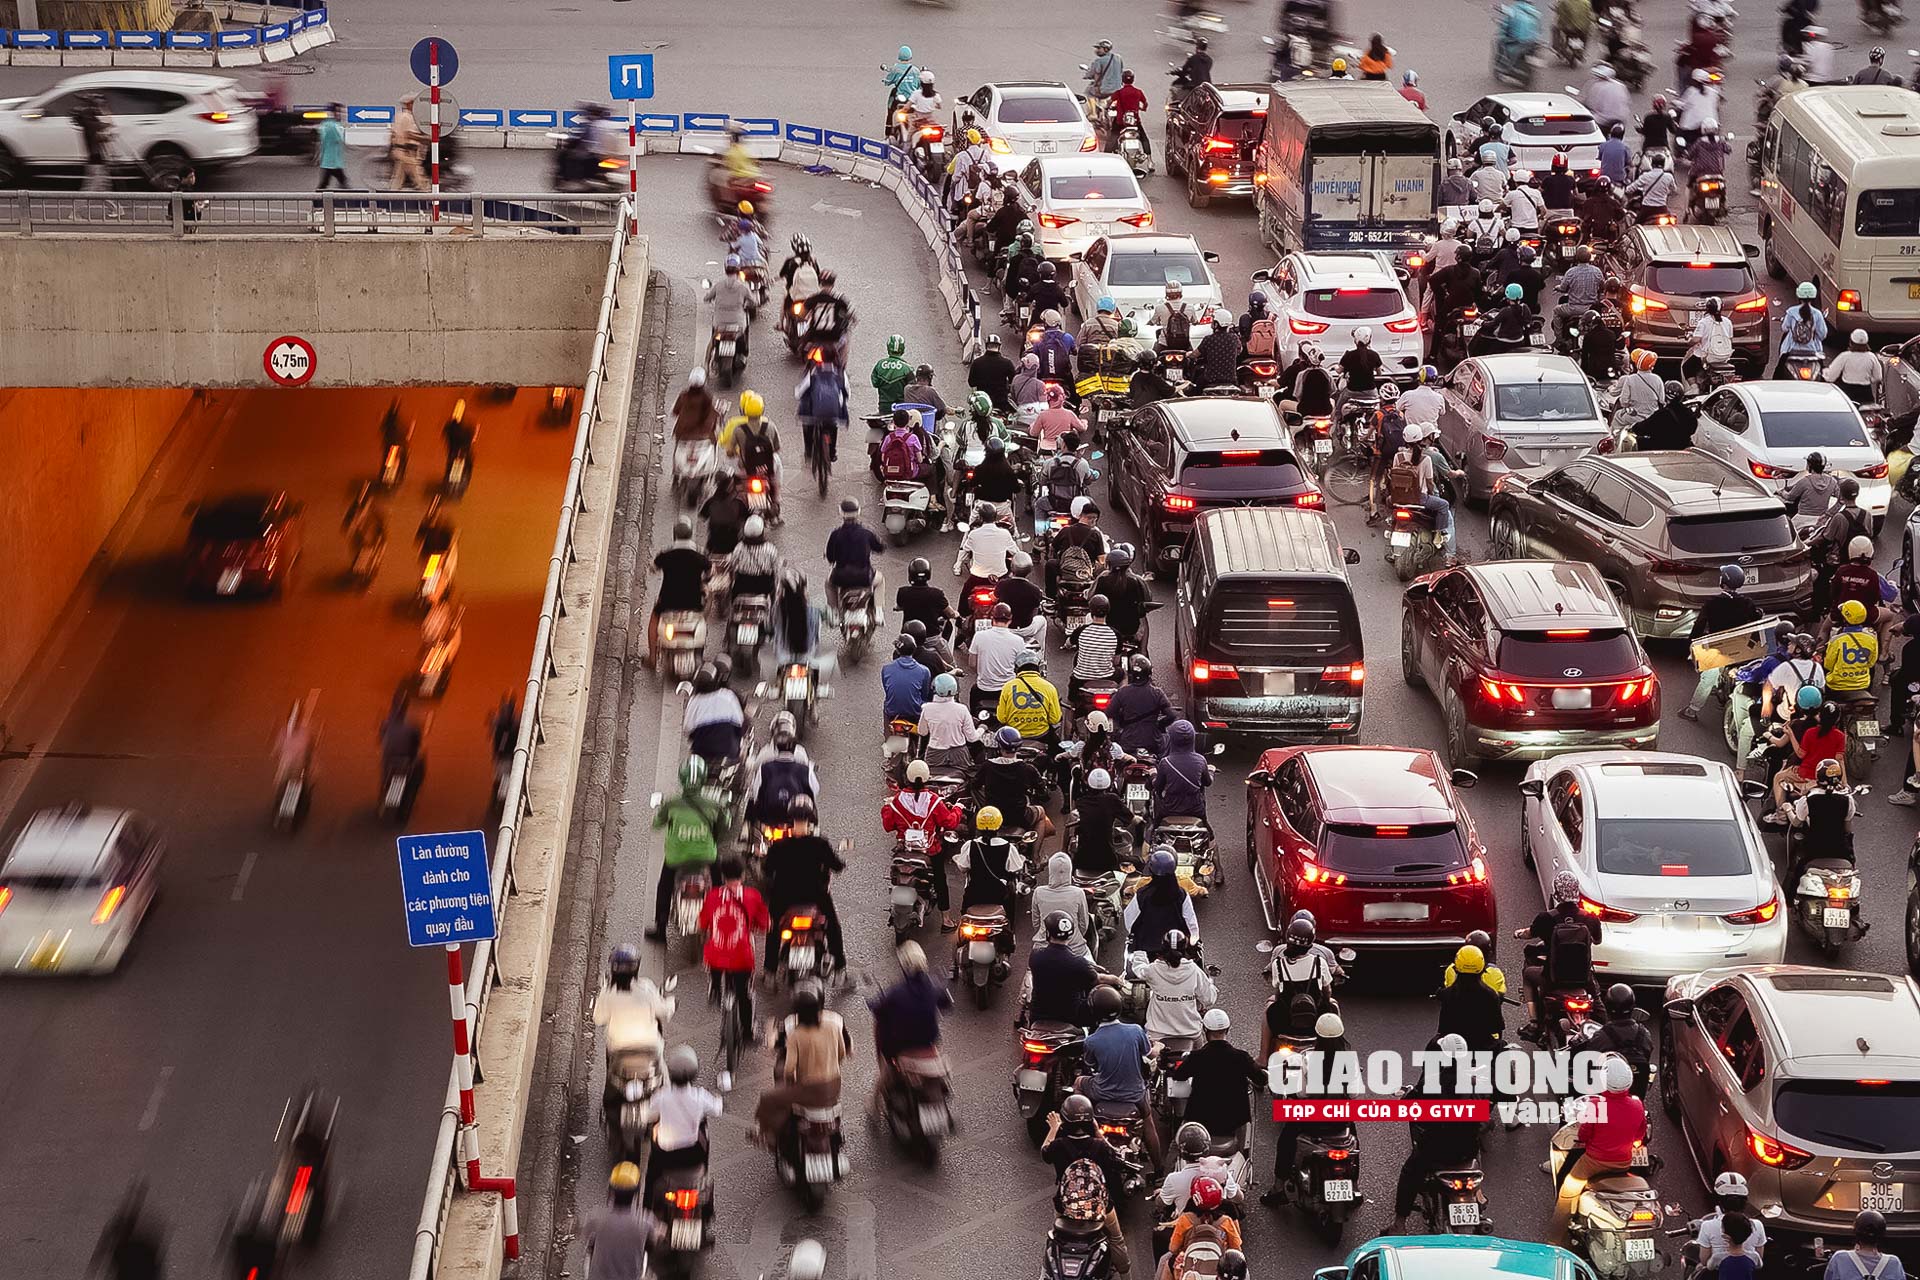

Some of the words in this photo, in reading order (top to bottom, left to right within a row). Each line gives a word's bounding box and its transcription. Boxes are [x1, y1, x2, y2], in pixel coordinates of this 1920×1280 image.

[1395, 179, 1424, 192] NHANH
[272, 354, 308, 369] 4,75m
[881, 360, 903, 370] Grab
[1842, 642, 1871, 665] be
[1012, 685, 1045, 709] be
[411, 845, 432, 860] Làn
[435, 843, 470, 859] đường
[422, 869, 448, 885] dành
[450, 868, 470, 882] cho
[408, 897, 428, 912] các
[429, 896, 468, 914] phương
[469, 892, 490, 907] tiện
[425, 922, 451, 938] quay
[454, 915, 475, 931] đầu
[1870, 1182, 1893, 1196] 30E
[1861, 1197, 1902, 1211] 830.70
